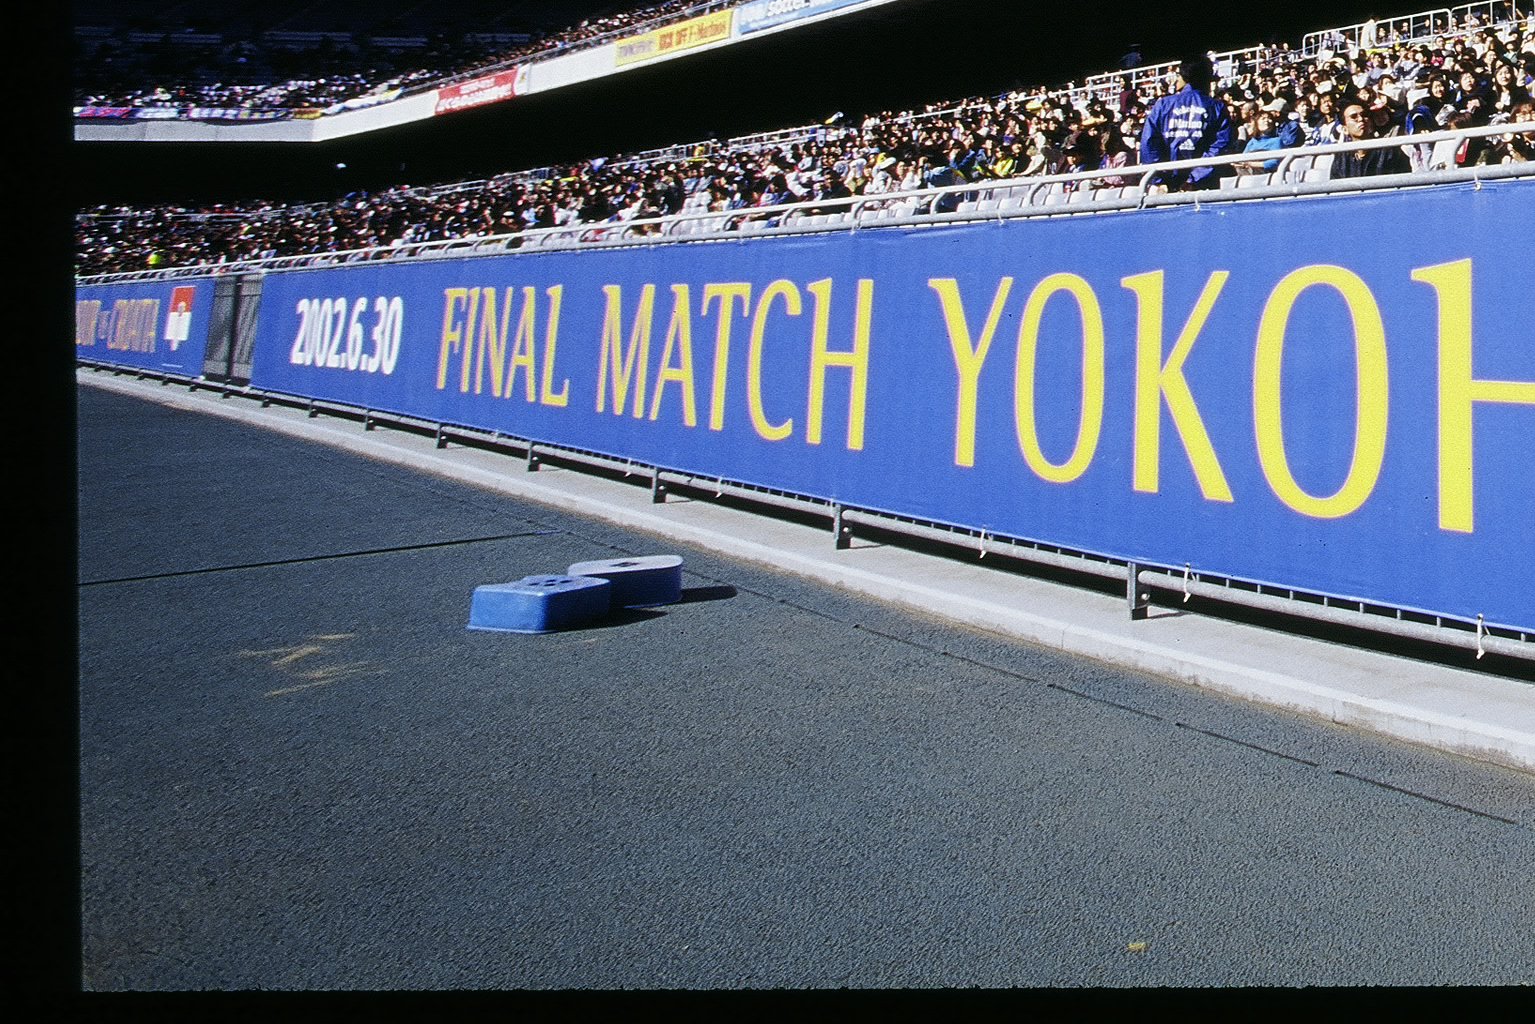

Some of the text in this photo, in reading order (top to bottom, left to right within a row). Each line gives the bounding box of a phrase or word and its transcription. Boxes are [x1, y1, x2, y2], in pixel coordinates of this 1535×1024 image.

[290, 295, 404, 376] 2002.6.30
[437, 284, 569, 407] FINAL
[596, 278, 873, 450] MATCH
